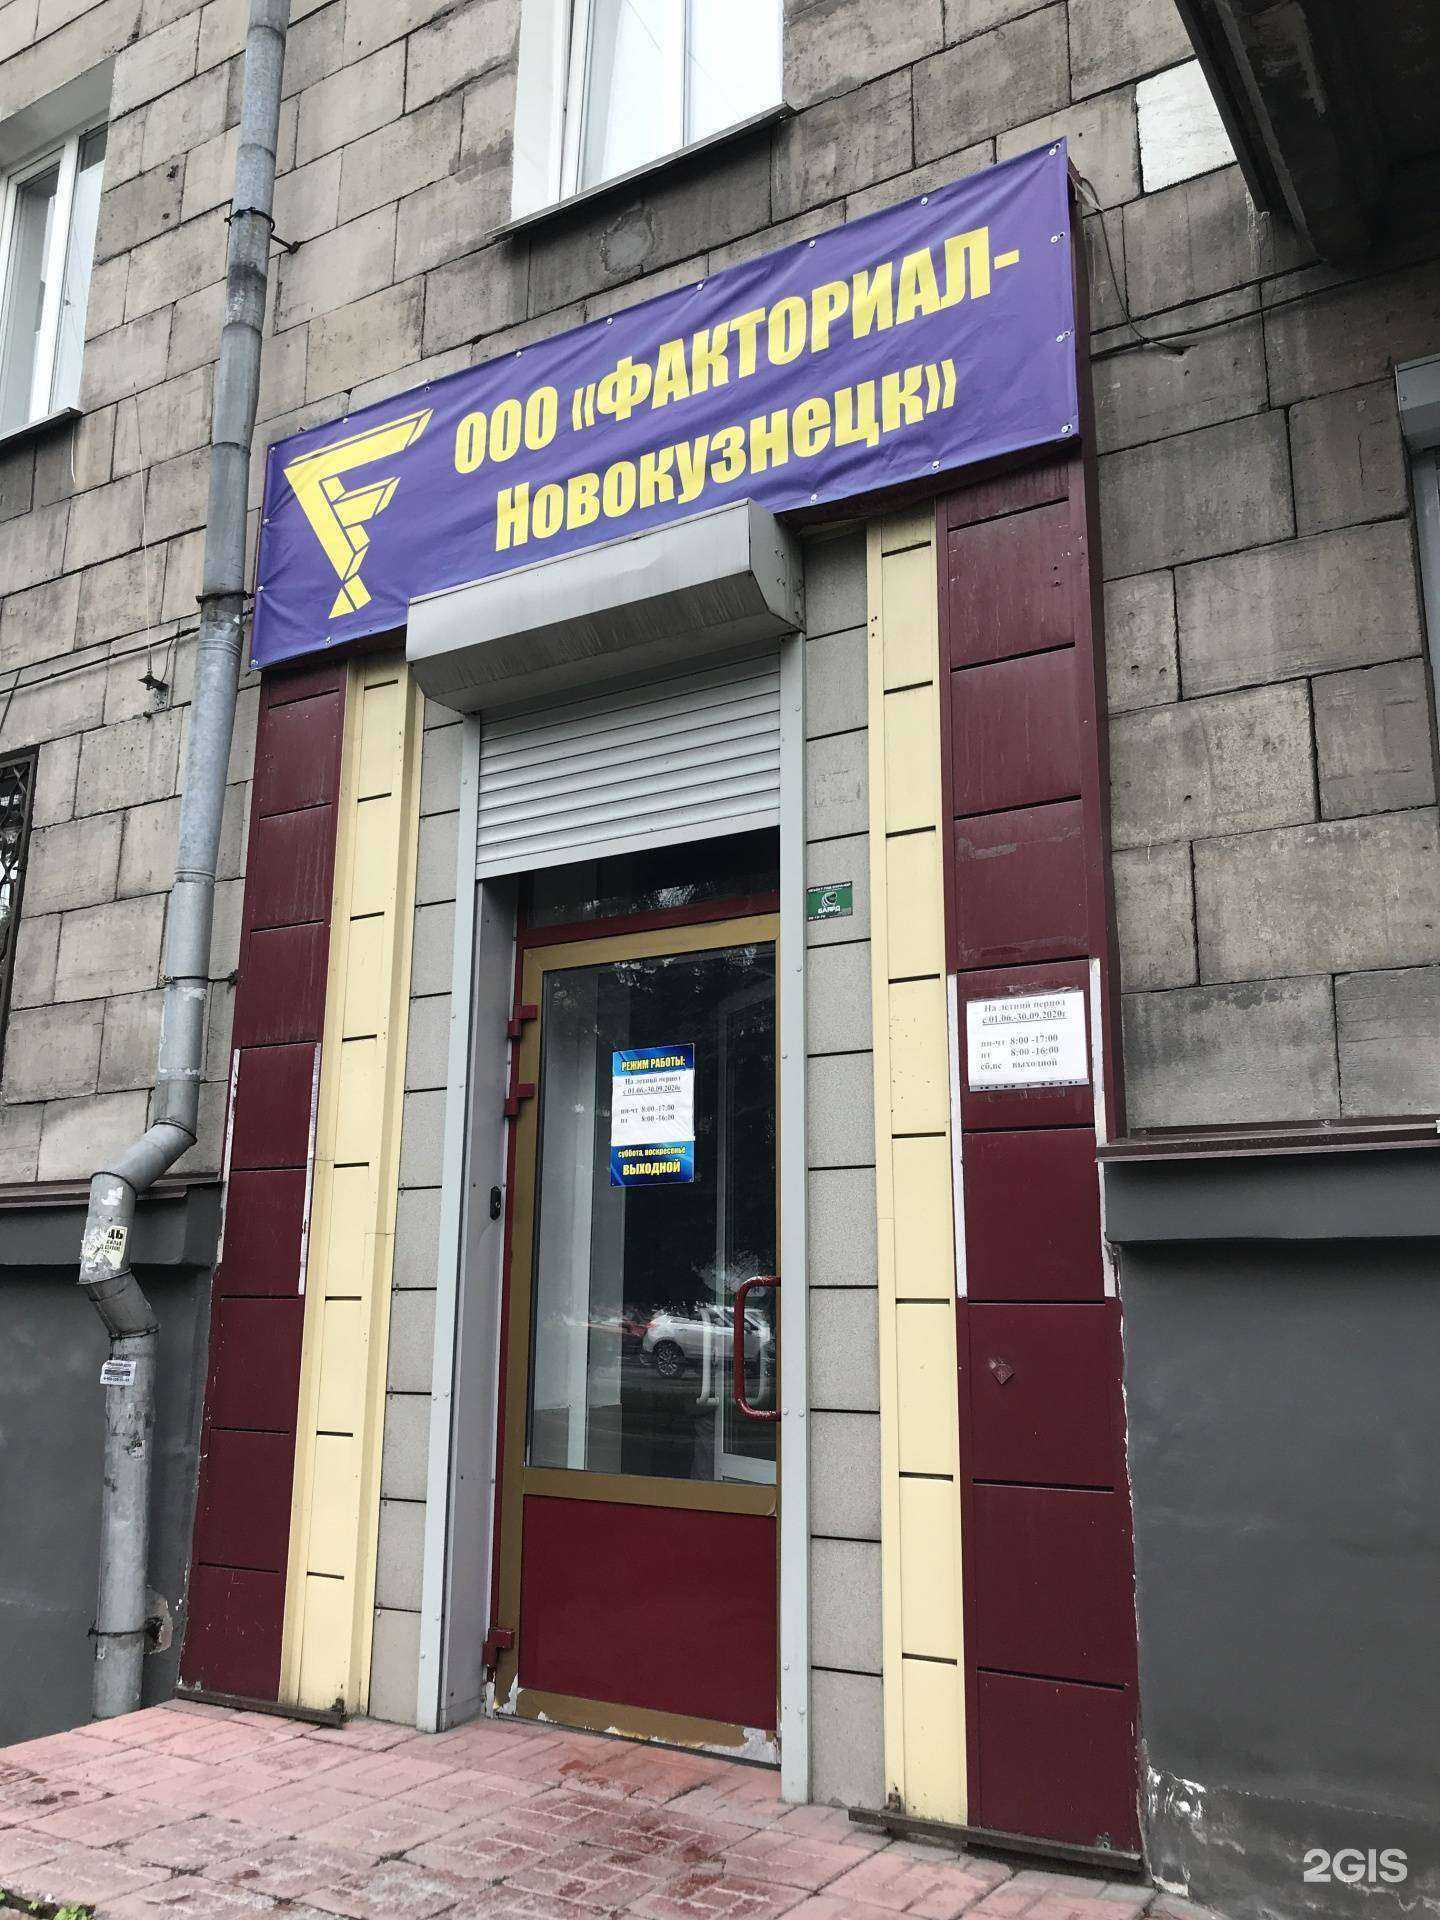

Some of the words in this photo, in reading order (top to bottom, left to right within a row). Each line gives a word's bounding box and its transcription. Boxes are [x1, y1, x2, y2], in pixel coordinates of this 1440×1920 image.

[454, 385, 559, 475] ООО
[571, 226, 1021, 432] «ФАКТОРИАЛ-
[983, 1004, 997, 1013] На
[999, 1001, 1031, 1011] летний
[1033, 1000, 1066, 1010] период
[1010, 1036, 1029, 1045] 8:00
[1010, 1048, 1030, 1057] 8:00
[621, 1059, 649, 1071] РЕЖИМ
[650, 1055, 686, 1069] РАБОТЫ:
[1012, 1058, 1058, 1069] выходной
[622, 1159, 681, 1176] ВЫХОДНОЙ
